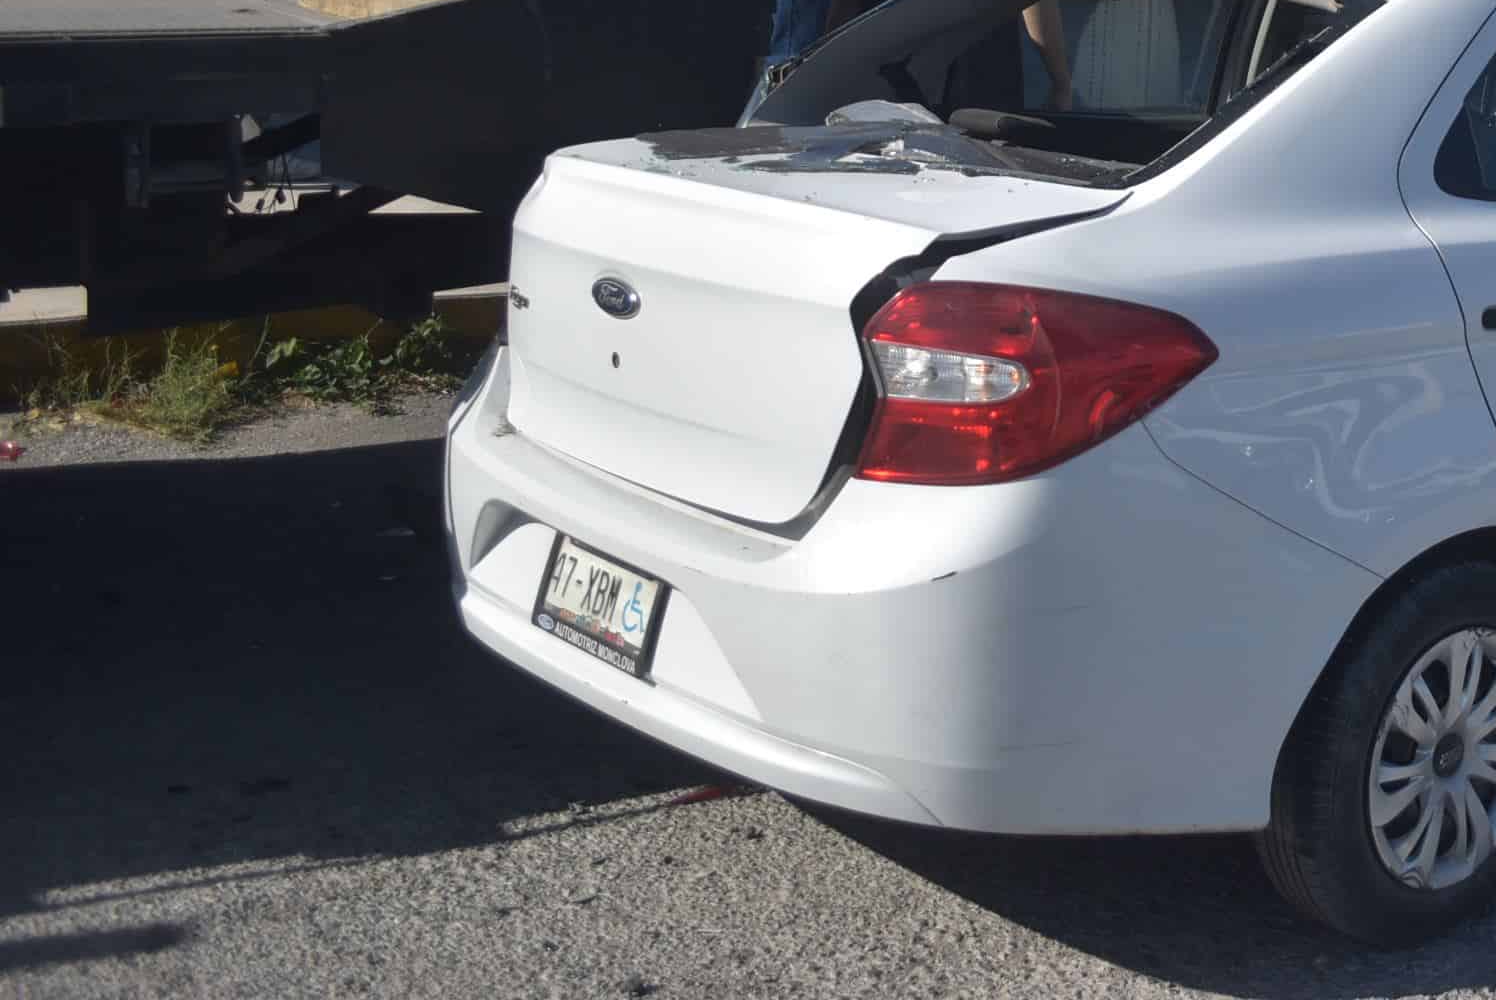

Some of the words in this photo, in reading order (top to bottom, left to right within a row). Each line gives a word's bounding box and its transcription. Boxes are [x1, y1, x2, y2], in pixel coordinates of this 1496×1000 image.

[600, 283, 625, 309] Ford
[554, 621, 599, 654] AUTOMOTRIZ
[599, 643, 636, 673] MONCLOVA
